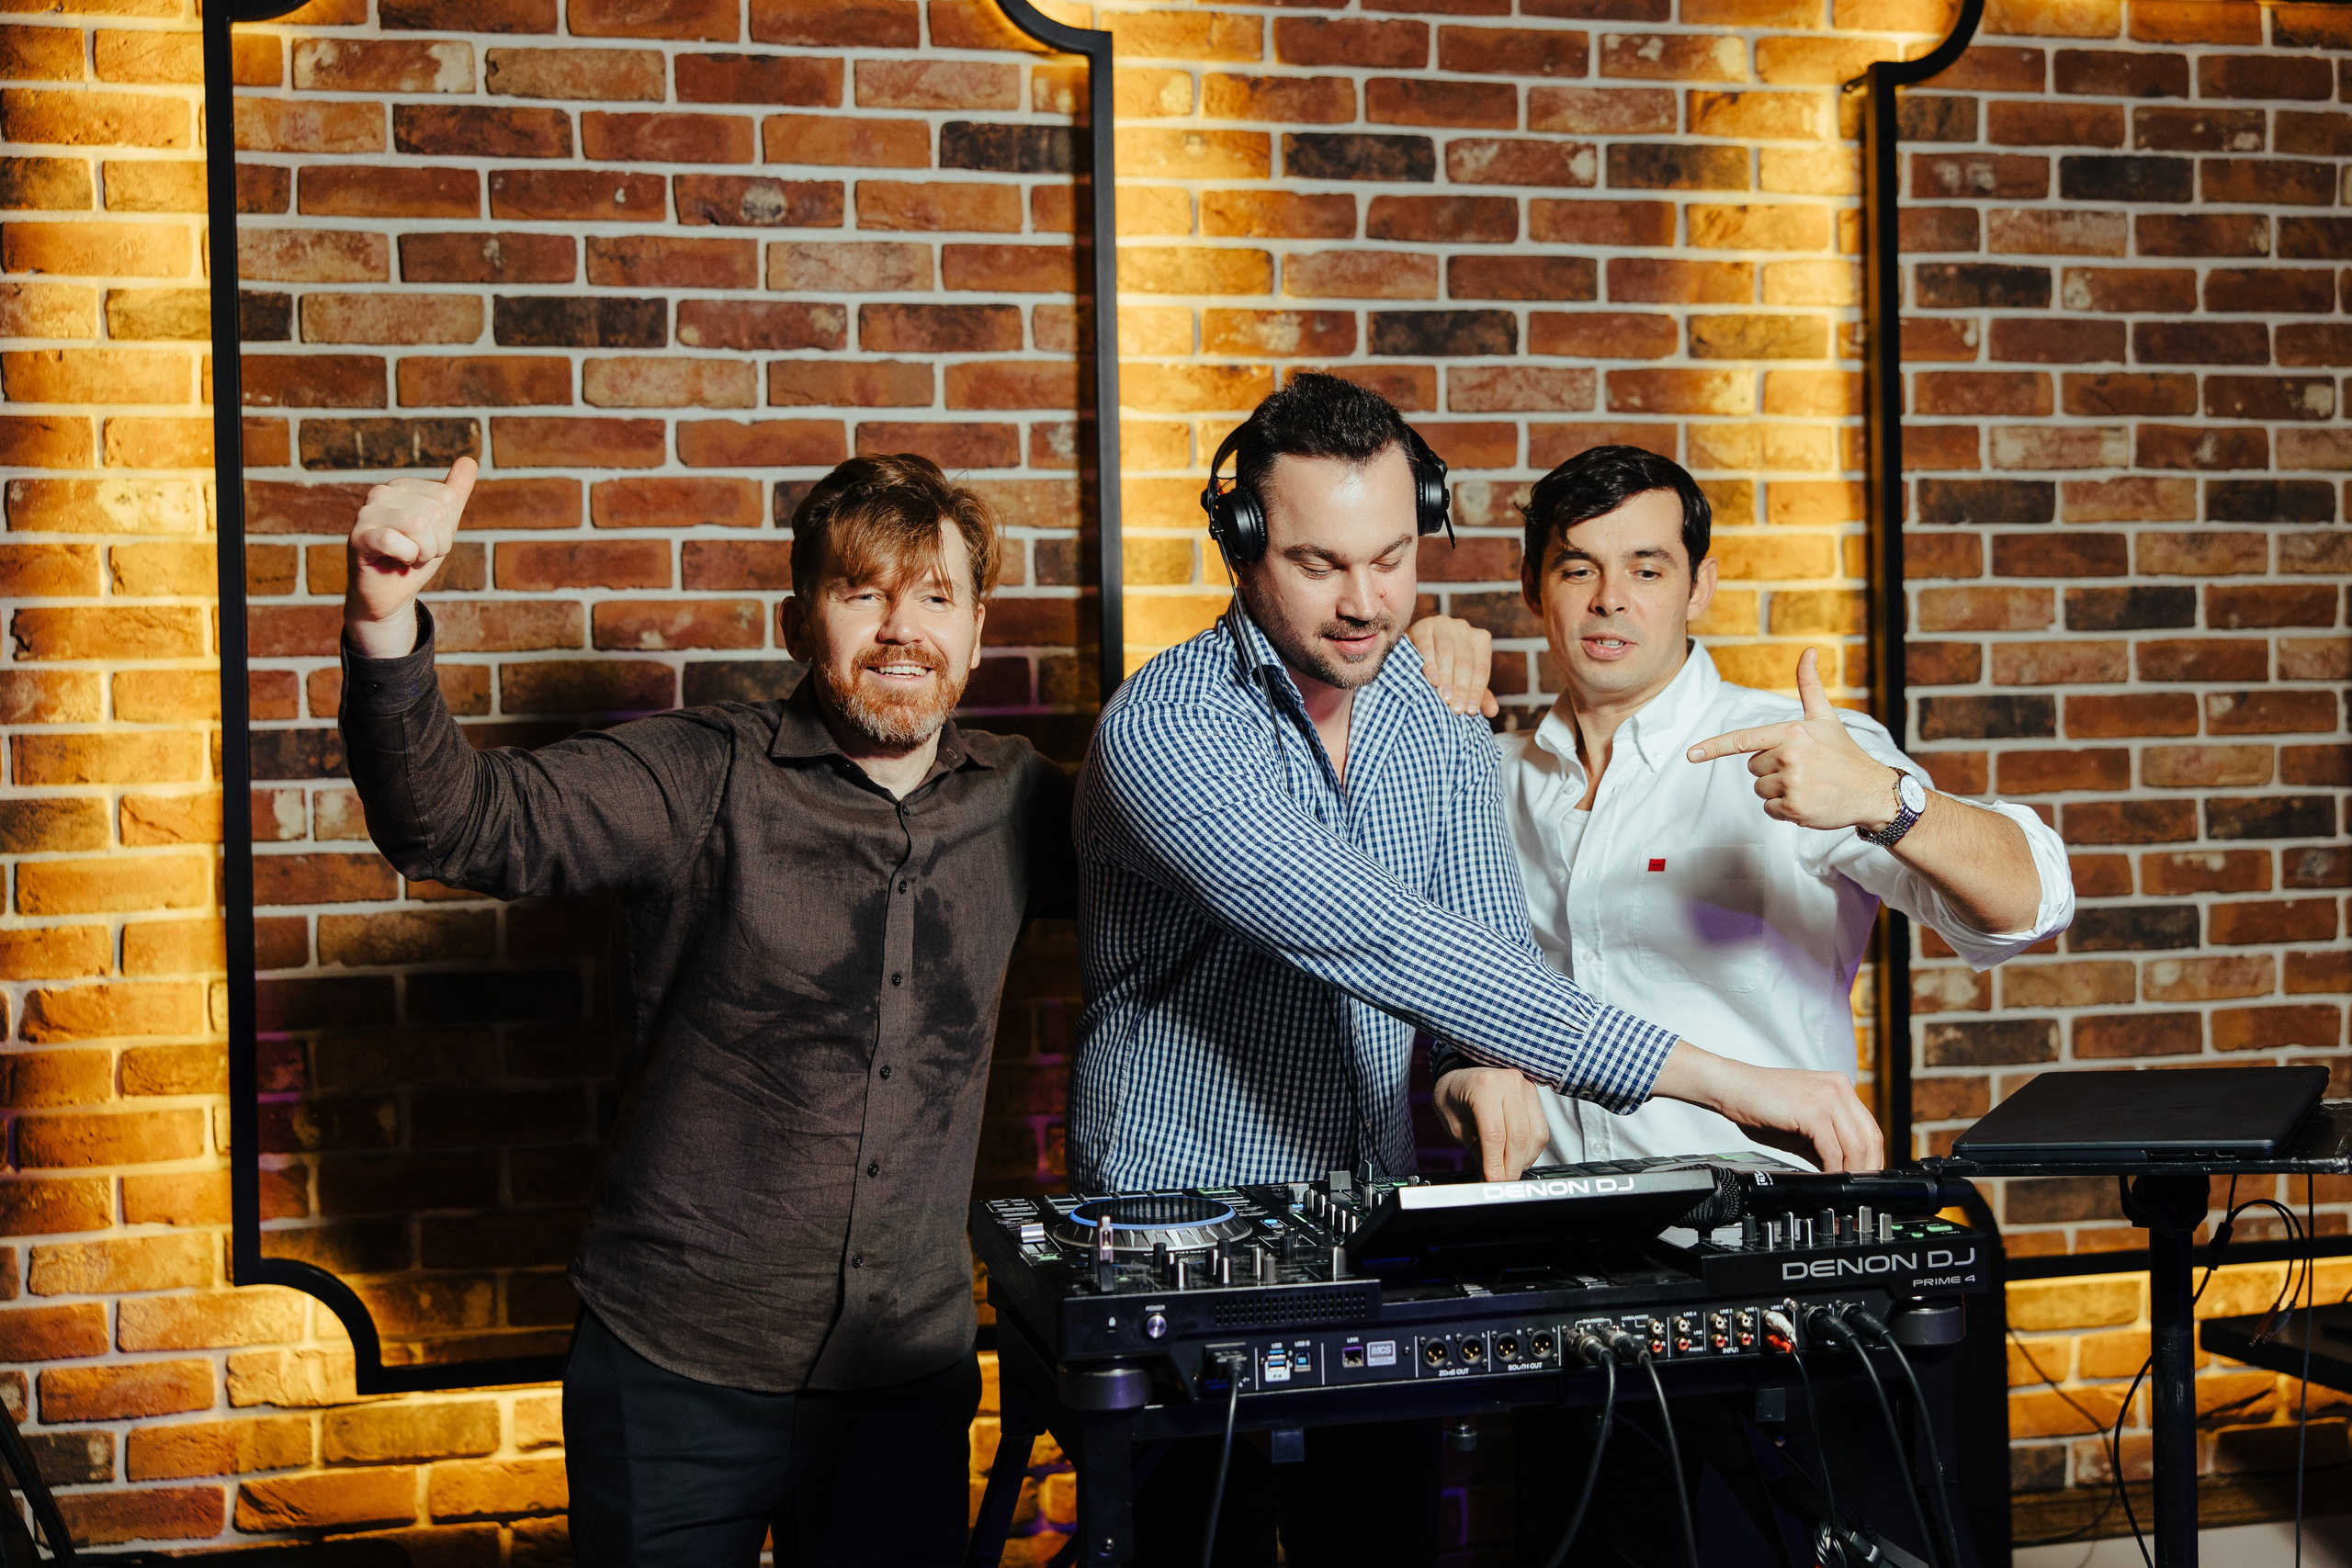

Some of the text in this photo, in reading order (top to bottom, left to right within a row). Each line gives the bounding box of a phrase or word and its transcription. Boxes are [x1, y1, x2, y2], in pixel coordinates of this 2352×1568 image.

[1483, 1177, 1634, 1200] DENON DJ
[1782, 1247, 1975, 1280] DENON DJ
[1913, 1274, 1975, 1287] PRIME 4
[1372, 1345, 1391, 1355] MCS
[1508, 1361, 1543, 1371] BOOTH OUT
[1439, 1369, 1455, 1377] ZONE
